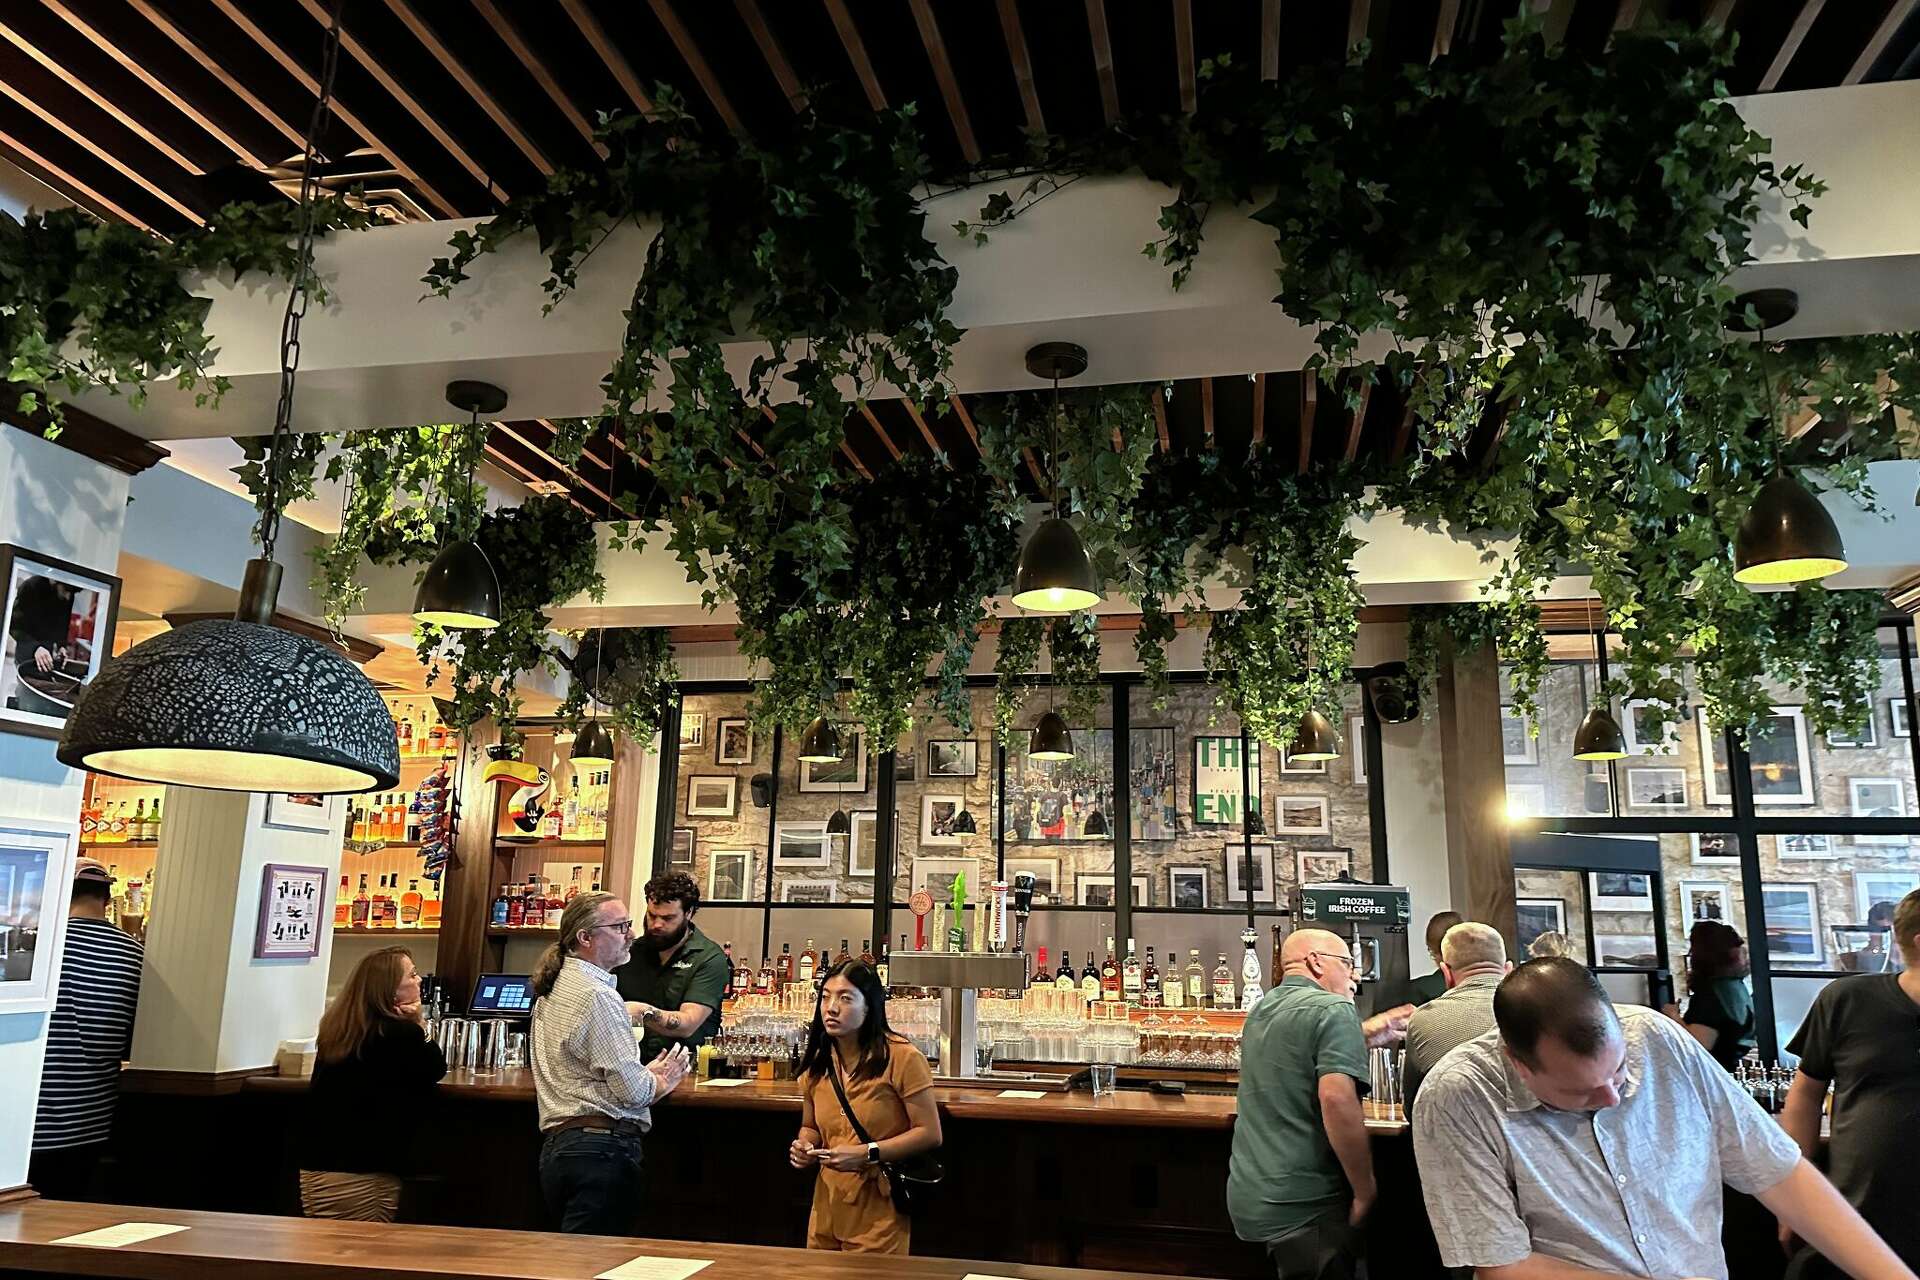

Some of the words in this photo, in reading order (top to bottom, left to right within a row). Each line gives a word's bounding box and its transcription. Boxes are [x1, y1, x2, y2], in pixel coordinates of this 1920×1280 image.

[1339, 897, 1374, 906] FROZEN
[1328, 904, 1352, 913] IRISH
[1352, 906, 1386, 914] COFFEE
